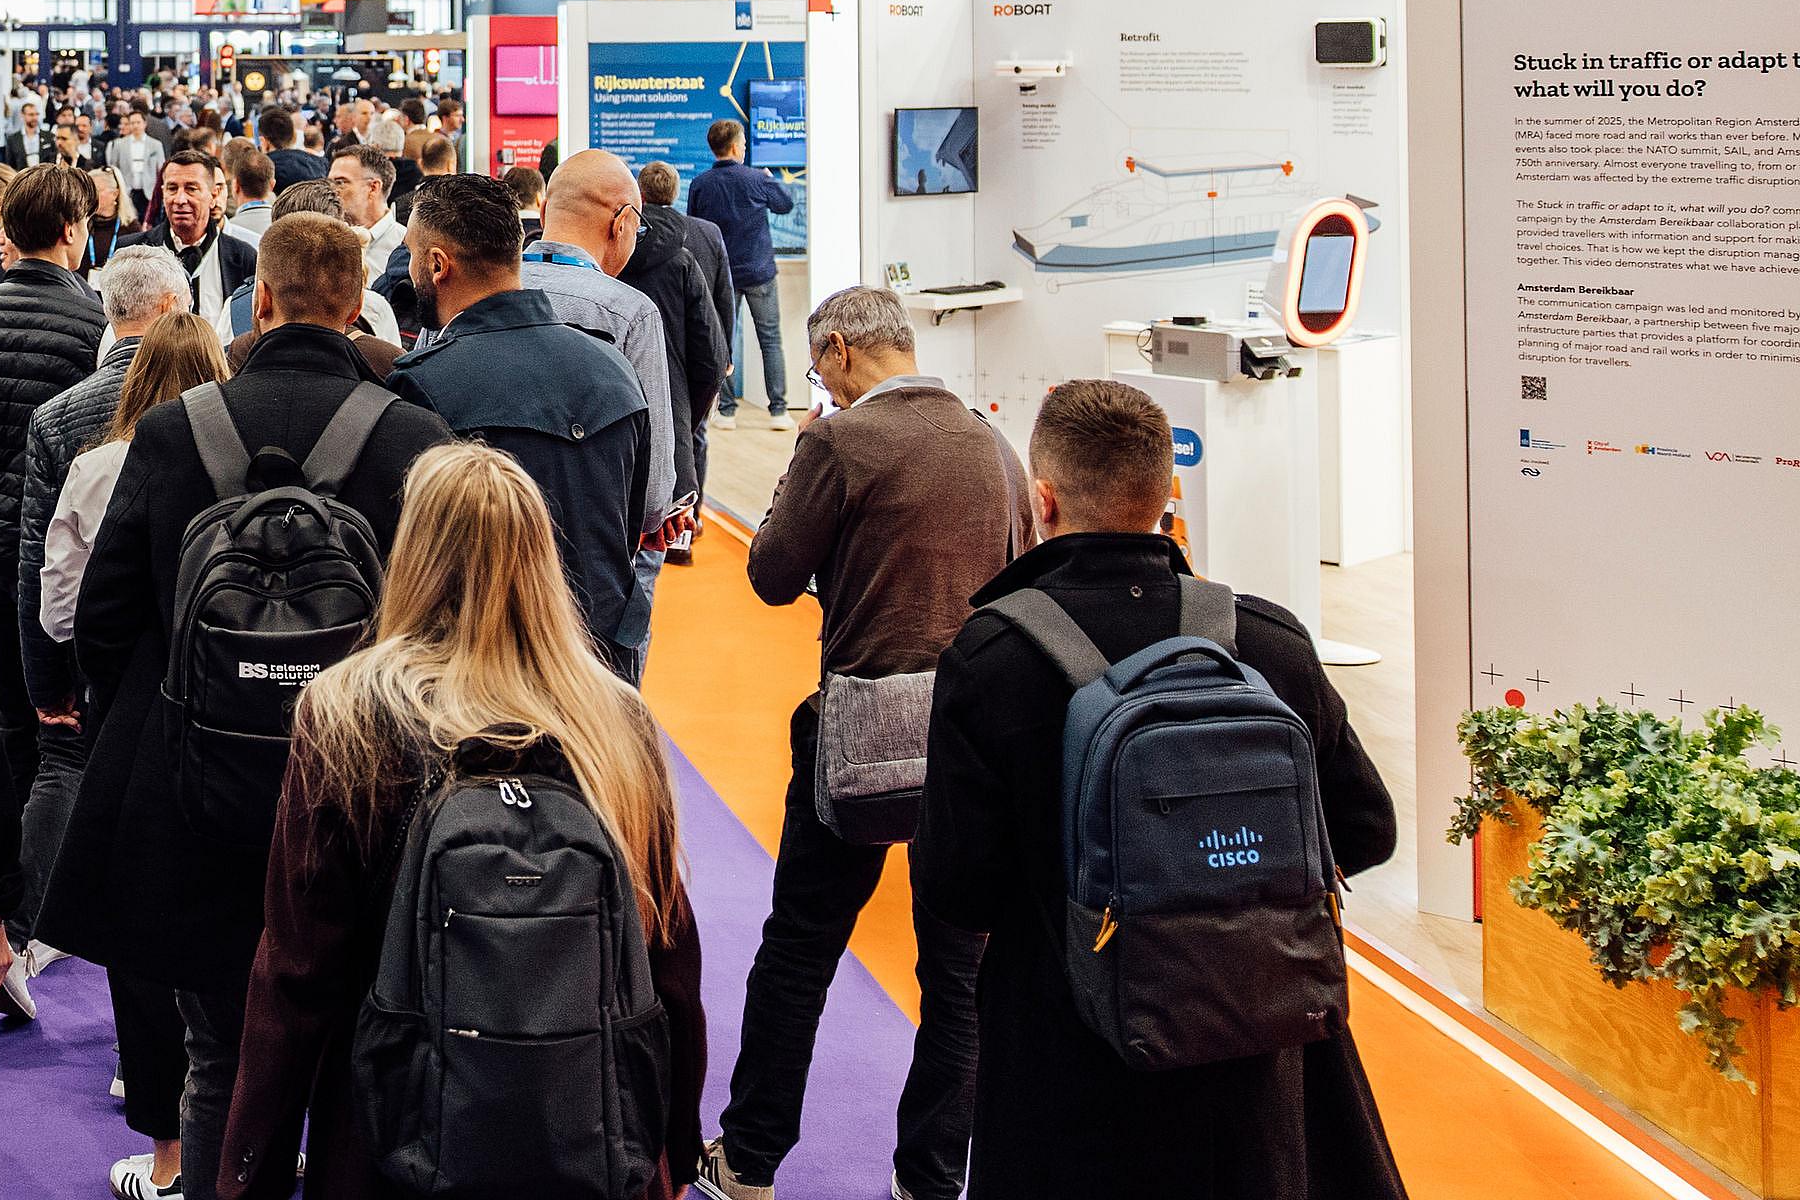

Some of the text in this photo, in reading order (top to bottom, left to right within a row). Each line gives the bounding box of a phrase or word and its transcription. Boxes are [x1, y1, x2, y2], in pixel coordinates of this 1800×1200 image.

[889, 3, 924, 17] ROBOAT
[993, 3, 1053, 17] ROBOAT
[1119, 32, 1161, 43] Retrofit
[1514, 52, 1576, 69] Stuck
[1581, 52, 1604, 69] in
[1608, 51, 1682, 69] traffic
[1687, 55, 1712, 68] or
[1717, 51, 1787, 73] adapt
[594, 75, 705, 92] Rijkswaterstaat
[1514, 79, 1706, 101] what will you do?
[595, 92, 688, 104] Using smart solutions
[1514, 116, 1523, 124] In
[1525, 116, 1541, 125] the
[1584, 116, 1595, 125] of
[1597, 116, 1627, 126] 2025,
[1627, 116, 1644, 125] the
[1647, 117, 1712, 128] Metropolitan
[1715, 117, 1752, 128] Region
[1514, 129, 1543, 141] (MRA)
[1545, 130, 1572, 139] faced
[1602, 130, 1625, 139] road
[1628, 131, 1647, 139] and
[1649, 131, 1666, 139] rail
[1667, 131, 1697, 140] works
[1699, 131, 1722, 140] than
[1751, 132, 1789, 140] before.
[1515, 144, 1546, 153] events
[1548, 144, 1568, 153] also
[1570, 144, 1592, 153] took
[1594, 145, 1624, 156] place:
[1627, 145, 1643, 154] the
[1646, 145, 1679, 154] NATO
[1680, 145, 1721, 156] summit,
[1724, 146, 1750, 156] SAIL,
[1753, 146, 1773, 155] and
[1515, 157, 1542, 166] 750th
[1544, 158, 1600, 169] anniversary.
[1603, 159, 1638, 168] Almost
[1640, 161, 1687, 171] everyone
[1690, 160, 1737, 171] travelling
[1740, 161, 1754, 170] to,
[1757, 161, 1782, 170] from
[1515, 171, 1570, 181] Amsterdam
[1593, 172, 1633, 182] affected
[1636, 173, 1648, 184] by
[1651, 174, 1668, 182] the
[1670, 175, 1712, 183] extreme
[1715, 175, 1744, 184] traffic
[1516, 199, 1534, 208] The
[1537, 199, 1563, 208] Stuck
[1565, 200, 1575, 209] in
[1577, 200, 1605, 209] traffic
[1621, 201, 1650, 213] adapt
[1653, 203, 1664, 211] to
[1666, 203, 1676, 212] it,
[1679, 203, 1704, 212] what
[1707, 204, 1725, 212] will
[1726, 206, 1747, 215] you
[1749, 205, 1771, 214] do?
[1516, 213, 1785, 229] campaign by the Amsterdam Bereikbaar collaboration
[1517, 282, 1634, 295] Amsterdam Bereikbaar
[238, 661, 268, 679] BS
